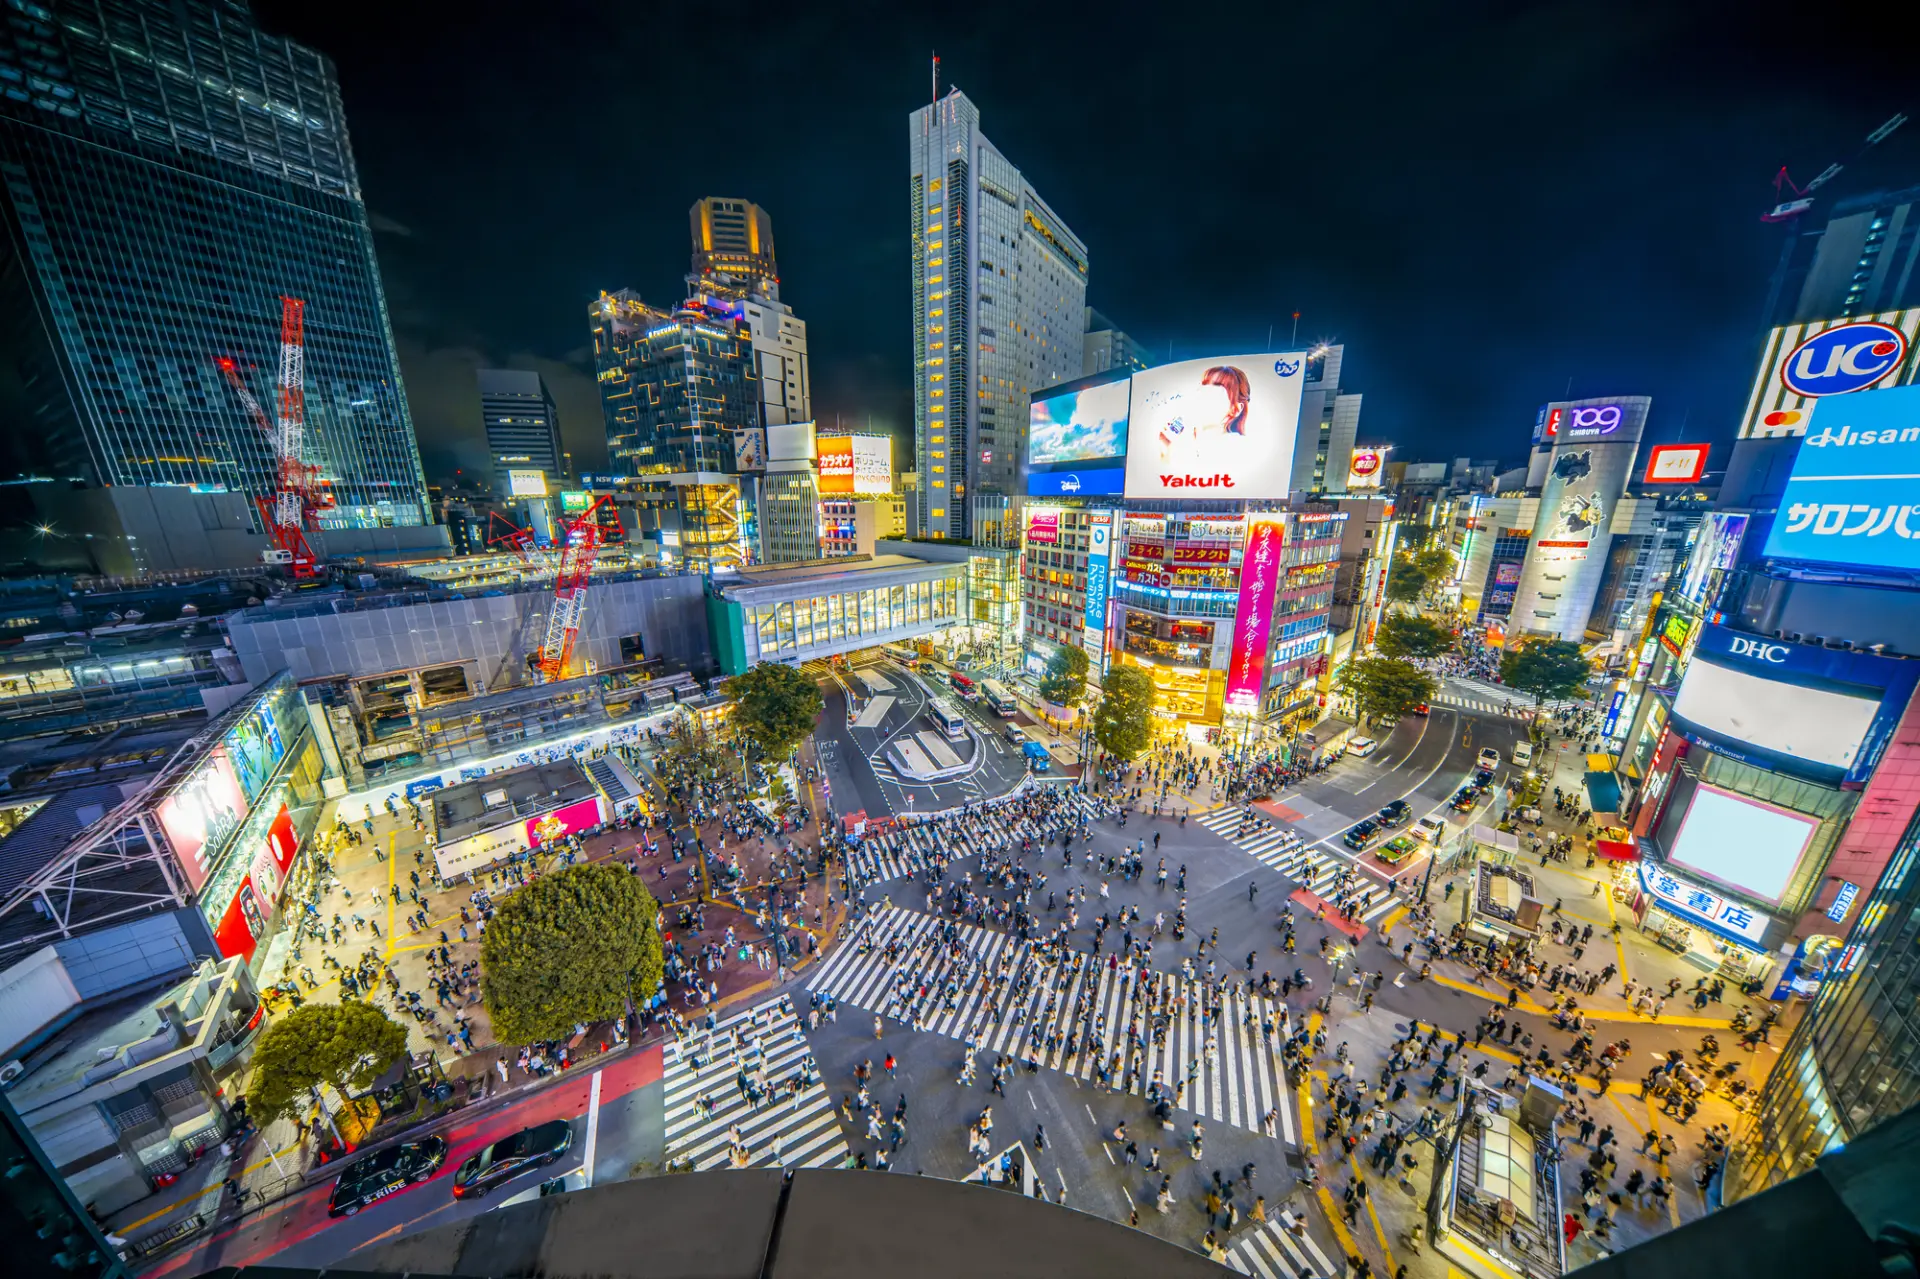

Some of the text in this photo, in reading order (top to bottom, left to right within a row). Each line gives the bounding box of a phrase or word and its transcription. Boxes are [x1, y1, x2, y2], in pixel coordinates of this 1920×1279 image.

[1796, 340, 1896, 379] UC
[1572, 407, 1621, 434] 109
[820, 454, 852, 466] カラオケ
[1159, 474, 1236, 488] Yakult
[1786, 503, 1920, 539] サロンパ
[1174, 549, 1228, 560] コンタクト
[1137, 572, 1159, 585] ガスト
[1147, 563, 1164, 574] ガスト
[1209, 567, 1235, 577] ガスト
[1088, 563, 1098, 616] アイシティ
[1095, 565, 1105, 618] コンタクトの
[1191, 592, 1239, 600] イーオン
[1728, 636, 1790, 663] DHC
[1714, 746, 1746, 760] Channel
[207, 811, 238, 856] SoftBan
[1643, 860, 1754, 930] 堂書店
